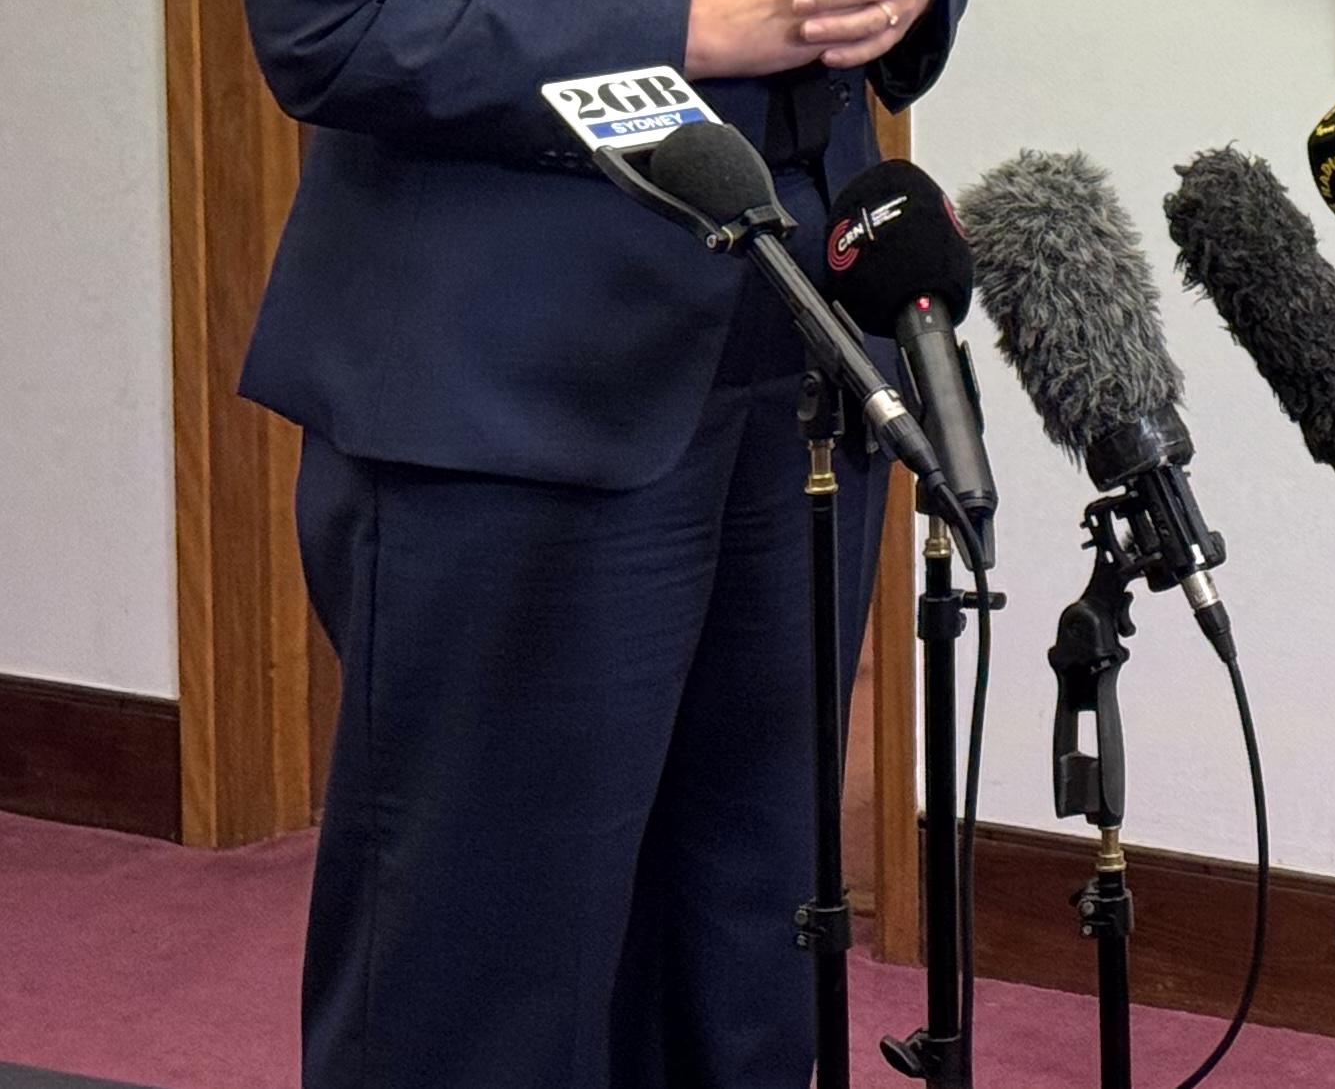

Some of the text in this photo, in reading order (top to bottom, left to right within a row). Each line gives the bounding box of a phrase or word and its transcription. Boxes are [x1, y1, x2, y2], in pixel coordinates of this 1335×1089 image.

[559, 75, 691, 120] 2GB
[610, 112, 684, 135] SYDNEY
[838, 223, 864, 252] CRN
